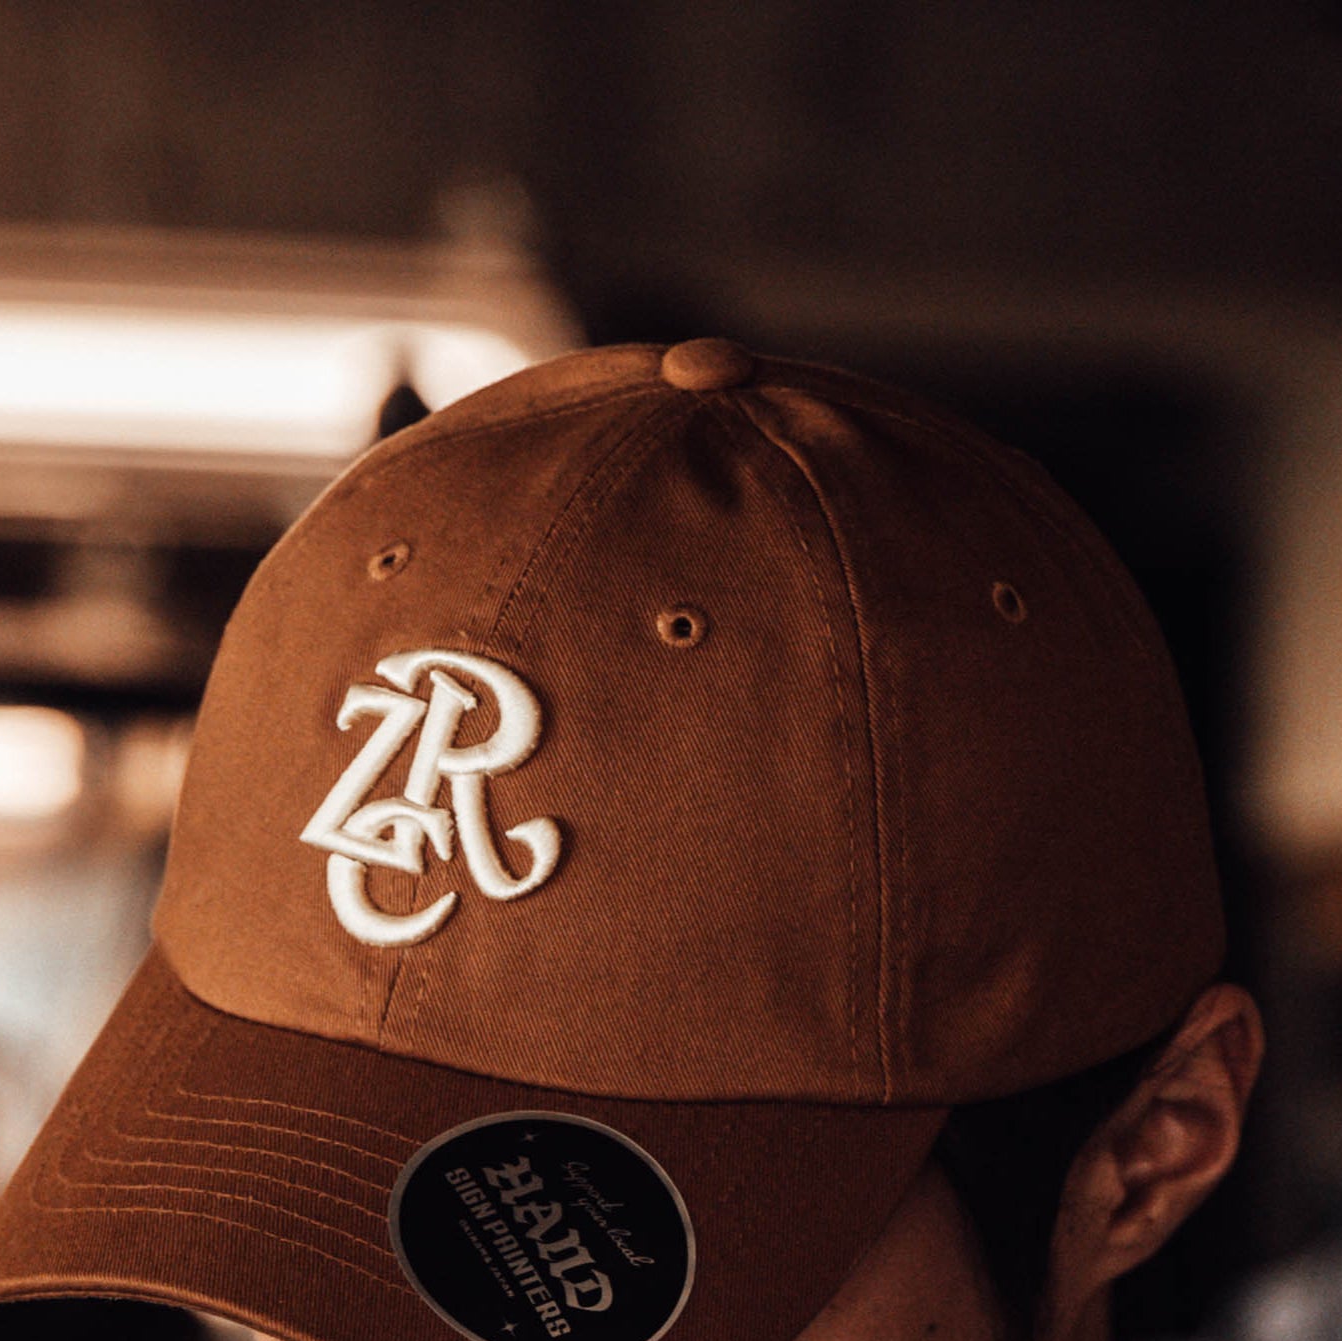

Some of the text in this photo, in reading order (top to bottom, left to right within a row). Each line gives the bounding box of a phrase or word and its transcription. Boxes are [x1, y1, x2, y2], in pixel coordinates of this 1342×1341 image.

[444, 1166, 571, 1339] SIGN PAINTERS
[482, 1155, 614, 1313] HAND
[606, 1228, 656, 1268] local
